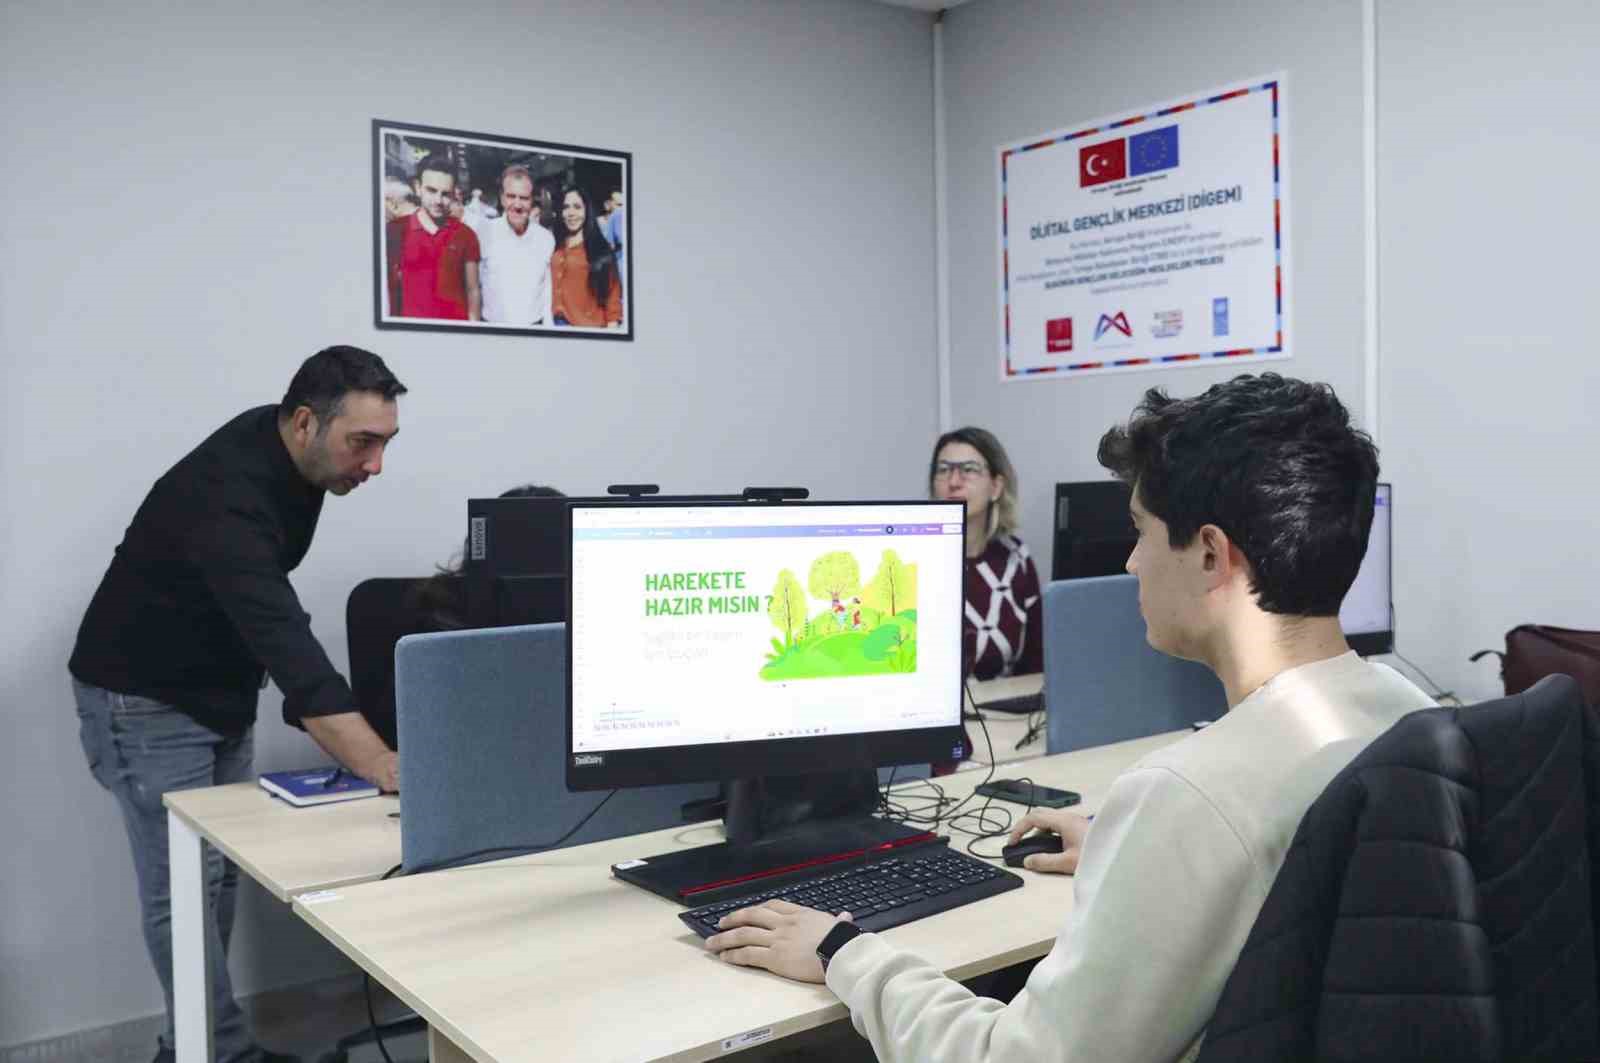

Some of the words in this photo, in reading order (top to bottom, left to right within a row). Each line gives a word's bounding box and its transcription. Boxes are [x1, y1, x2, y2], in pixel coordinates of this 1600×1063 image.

[1073, 208, 1126, 232] GENÇLİK
[1128, 198, 1184, 222] MERKEZİ
[645, 571, 746, 592] HAREKETE
[645, 597, 703, 616] HAZIR
[708, 595, 759, 614] MISIN
[764, 595, 775, 612] ?
